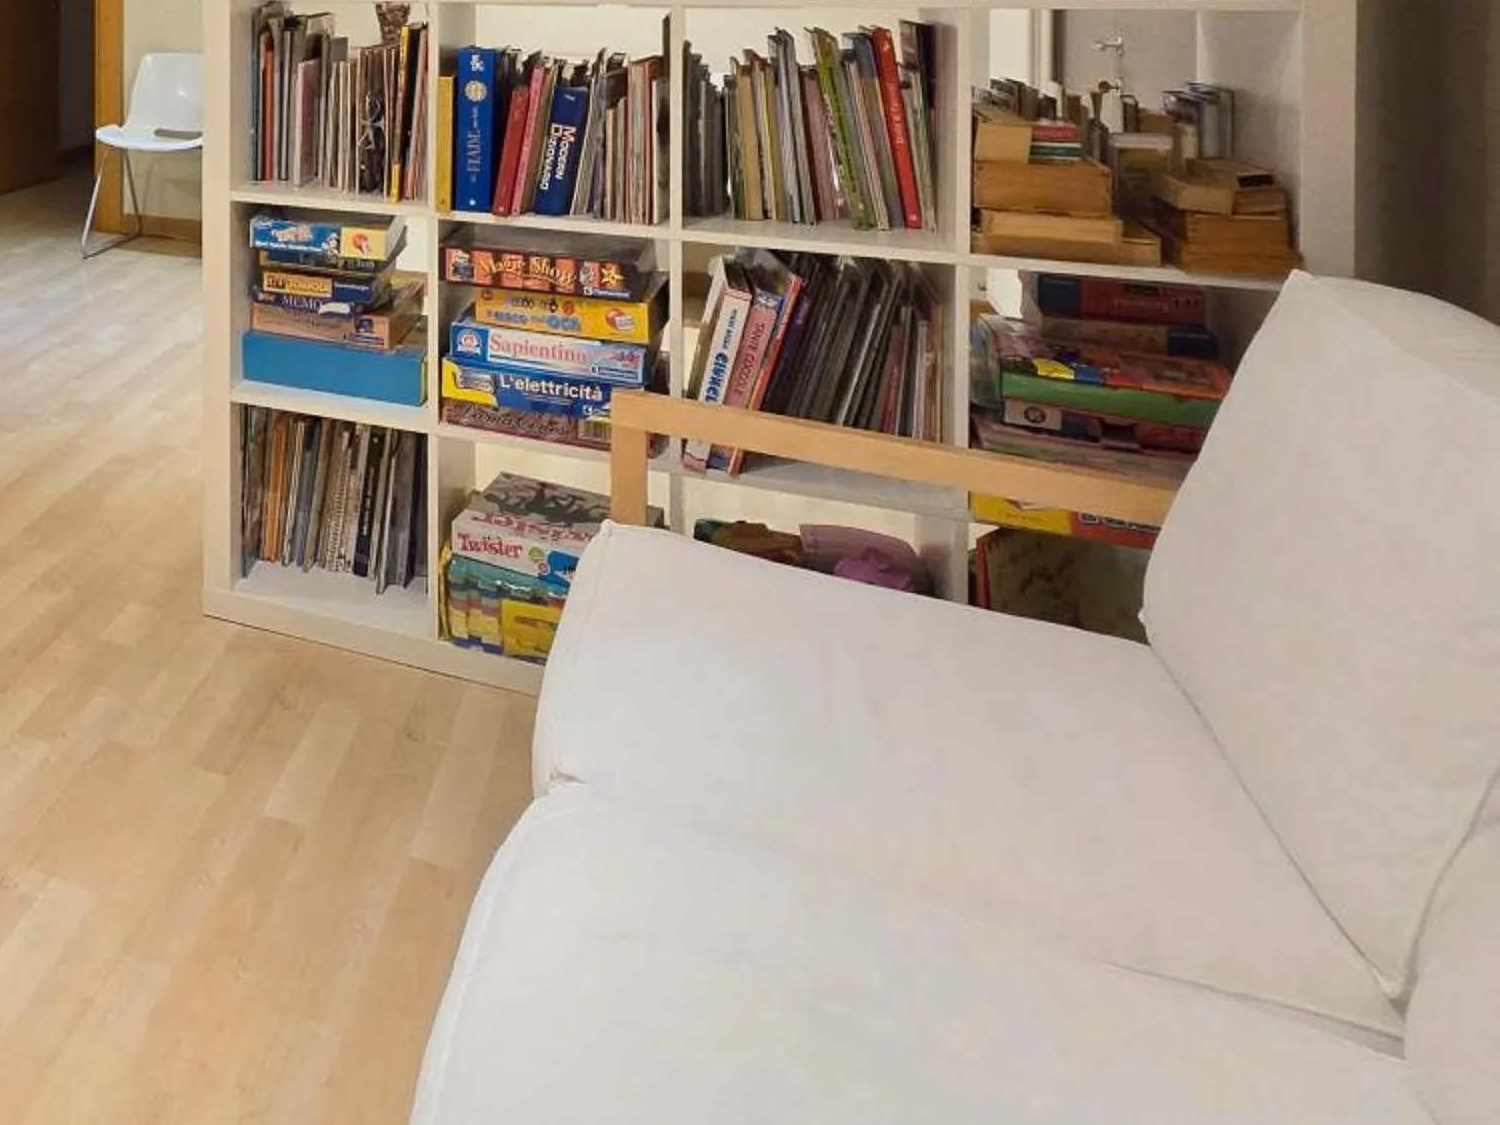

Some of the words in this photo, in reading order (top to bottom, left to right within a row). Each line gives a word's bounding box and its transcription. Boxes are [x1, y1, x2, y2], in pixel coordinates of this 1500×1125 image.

[489, 331, 588, 364] Sapientino
[500, 375, 603, 402] L'elettricità
[457, 532, 524, 559] Twister
